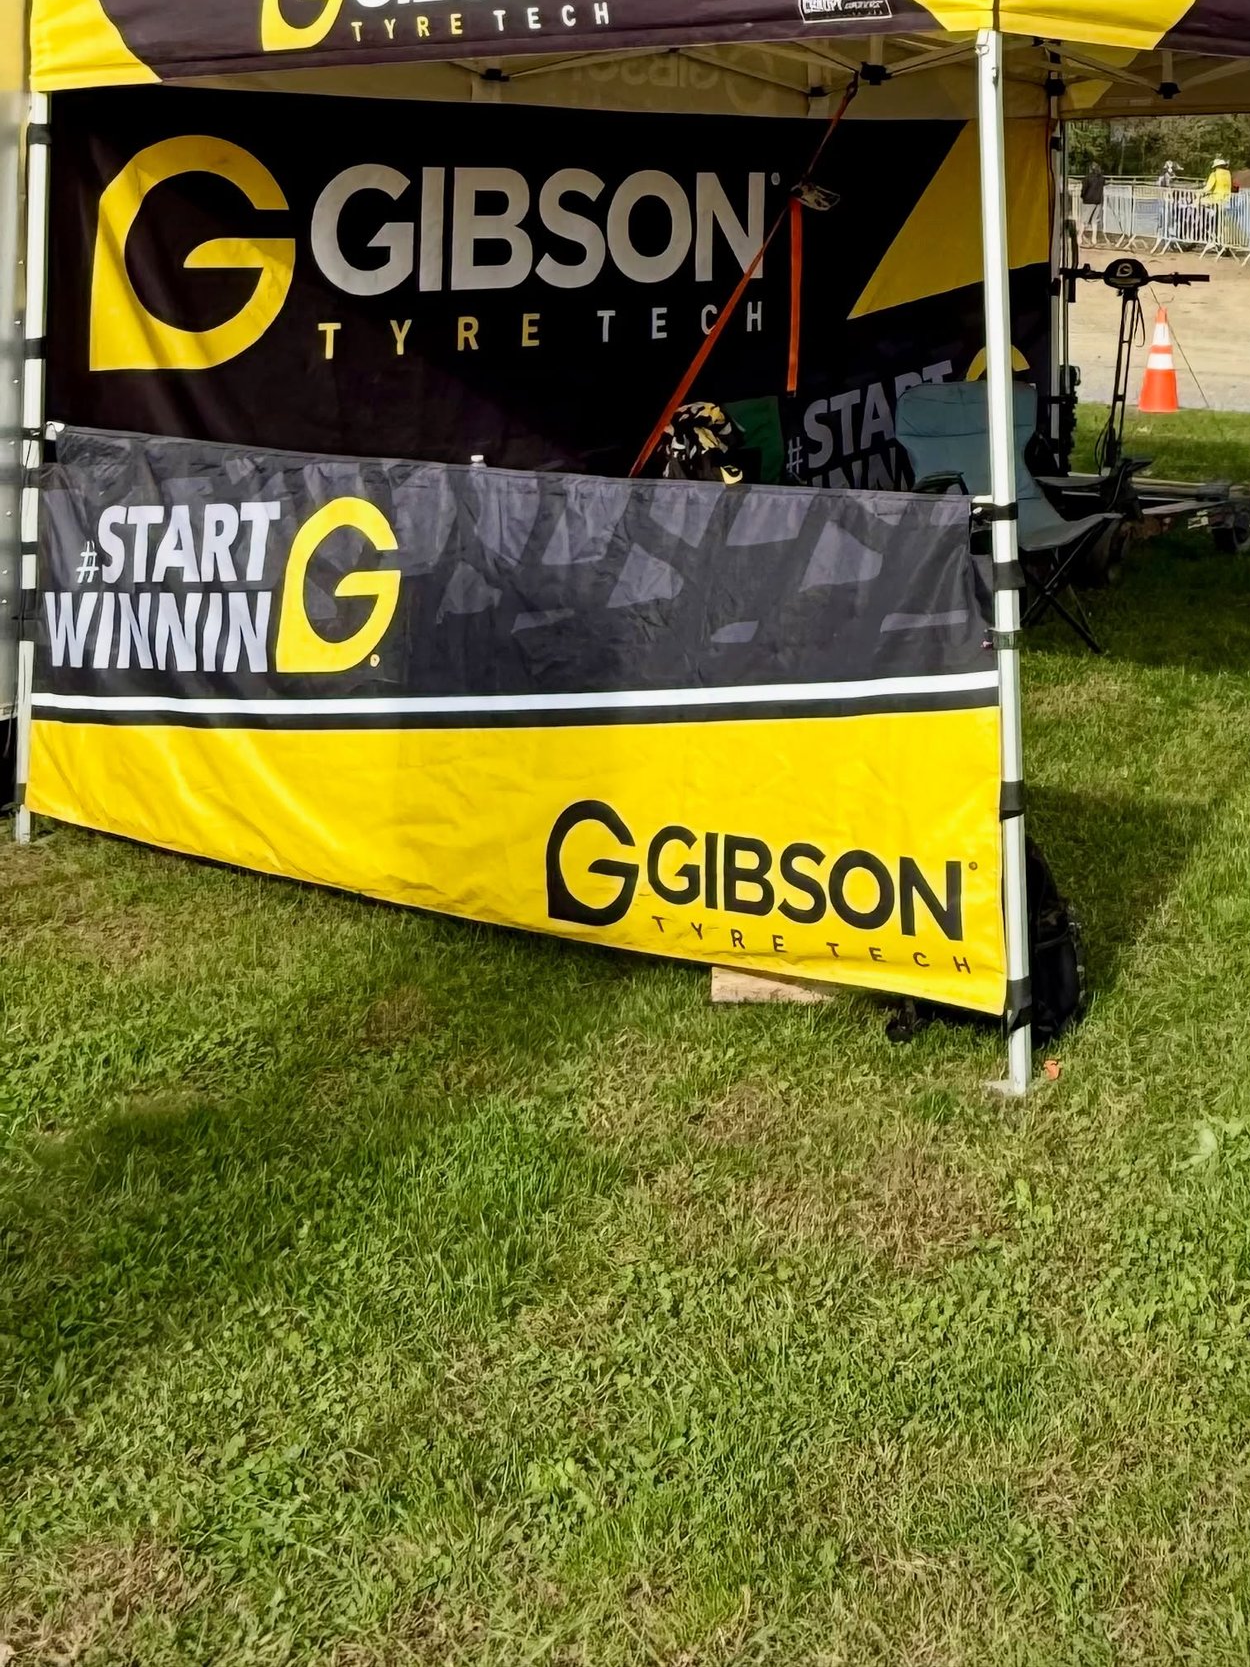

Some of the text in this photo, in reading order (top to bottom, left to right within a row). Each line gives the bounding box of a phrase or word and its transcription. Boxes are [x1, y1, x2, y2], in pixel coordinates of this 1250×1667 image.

[350, 2, 611, 43] TYRE TECH
[310, 163, 766, 297] GIBSON
[318, 301, 763, 360] TYRE TECH
[76, 500, 281, 584] #START
[646, 825, 963, 942] GIBSON
[651, 915, 971, 974] TYRE TECH
